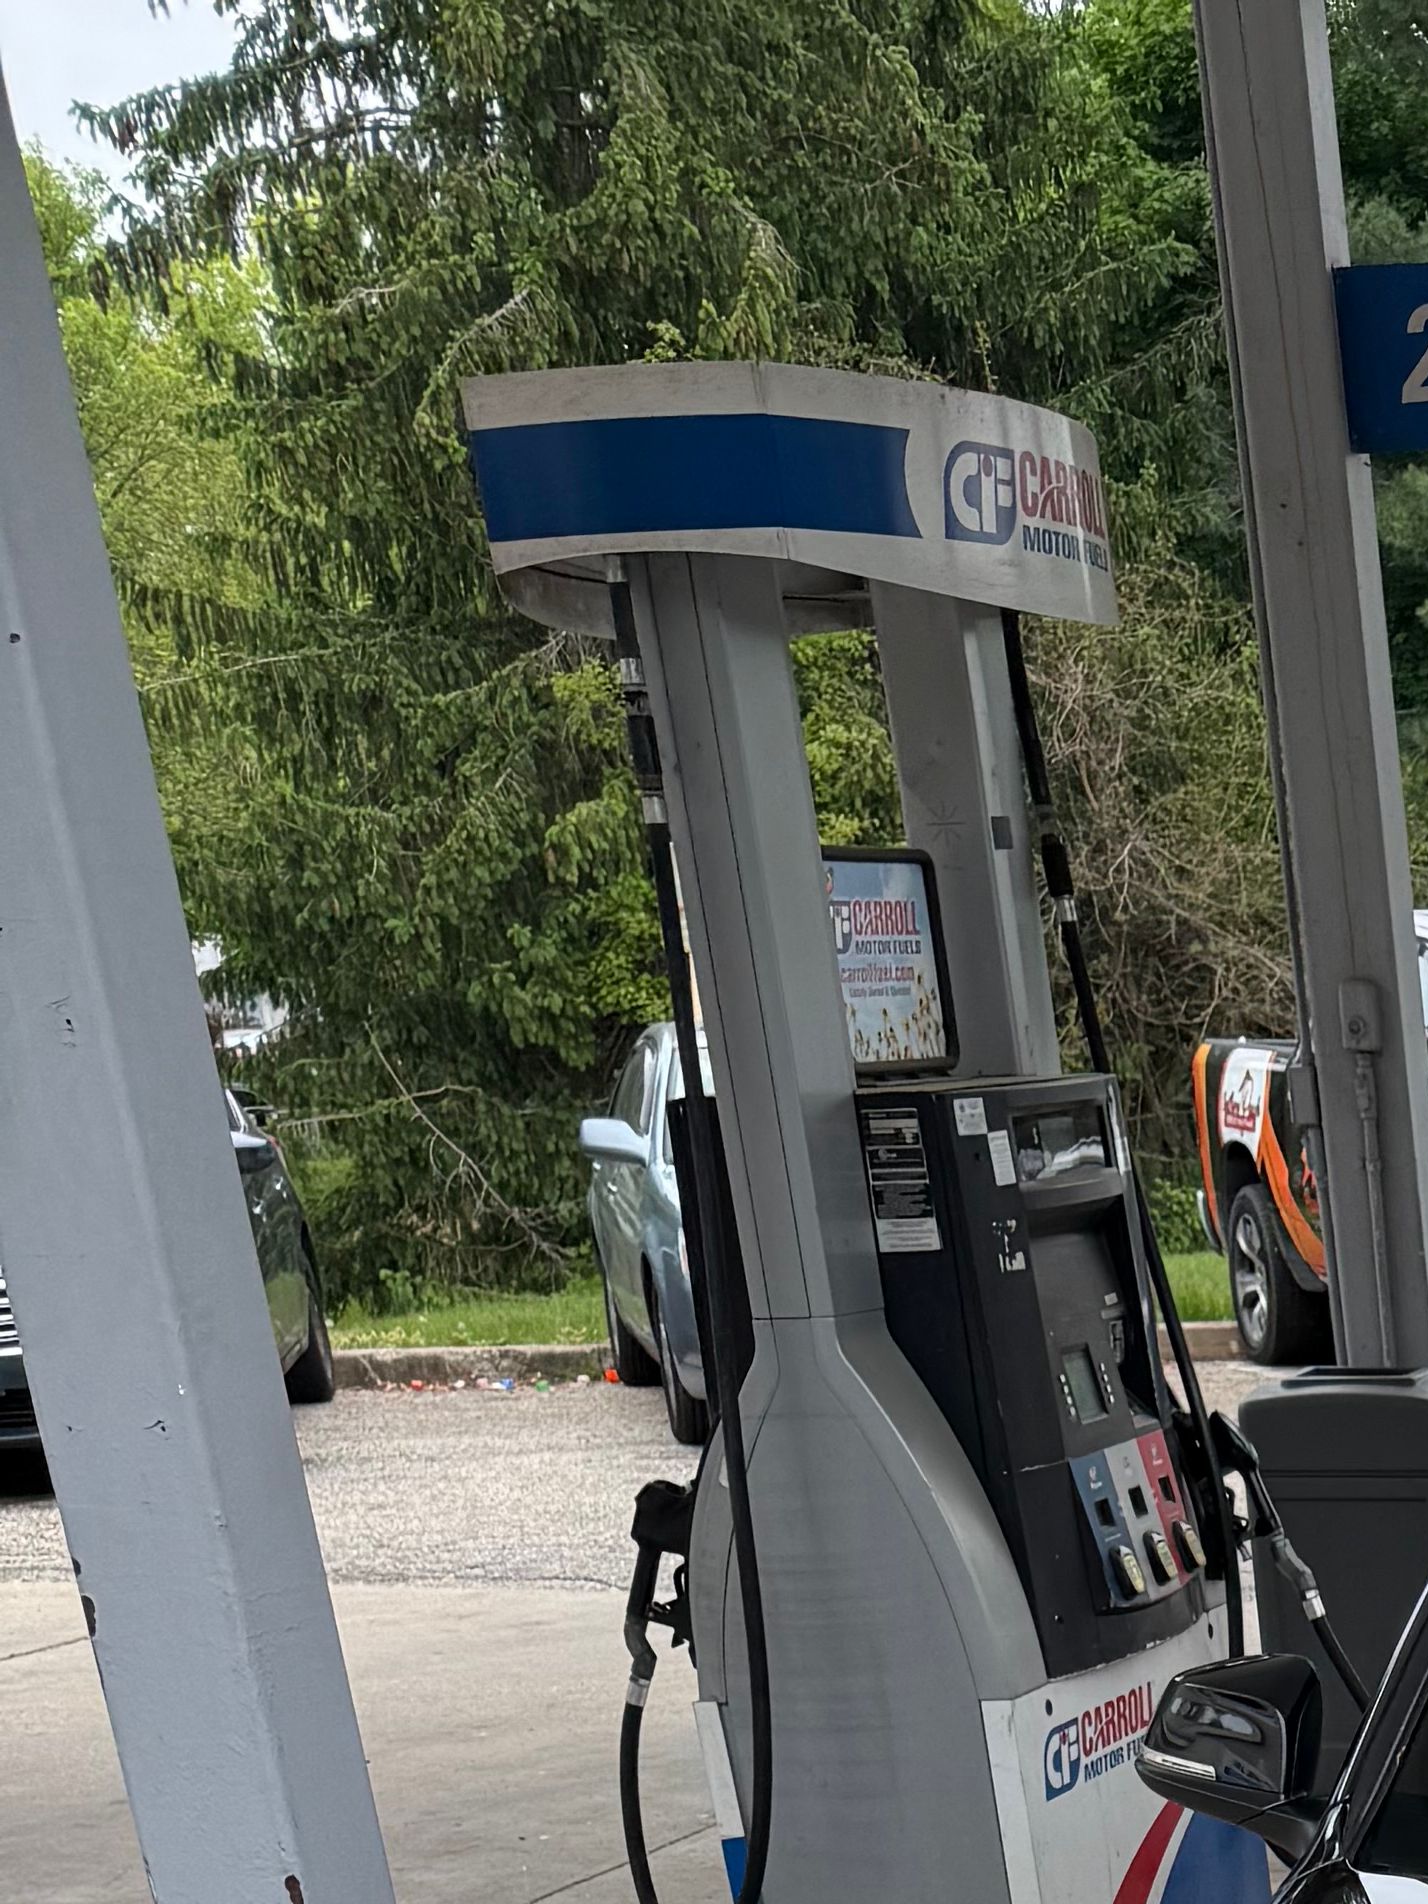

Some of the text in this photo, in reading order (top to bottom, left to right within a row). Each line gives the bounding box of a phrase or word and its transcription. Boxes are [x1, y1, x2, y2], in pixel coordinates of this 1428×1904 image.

[1019, 451, 1105, 540] CARROLL
[1023, 525, 1081, 562] MOTOR
[853, 900, 920, 936] CARROLL
[1081, 1681, 1154, 1757] CARROLL
[1084, 1746, 1125, 1783] MOTOR
